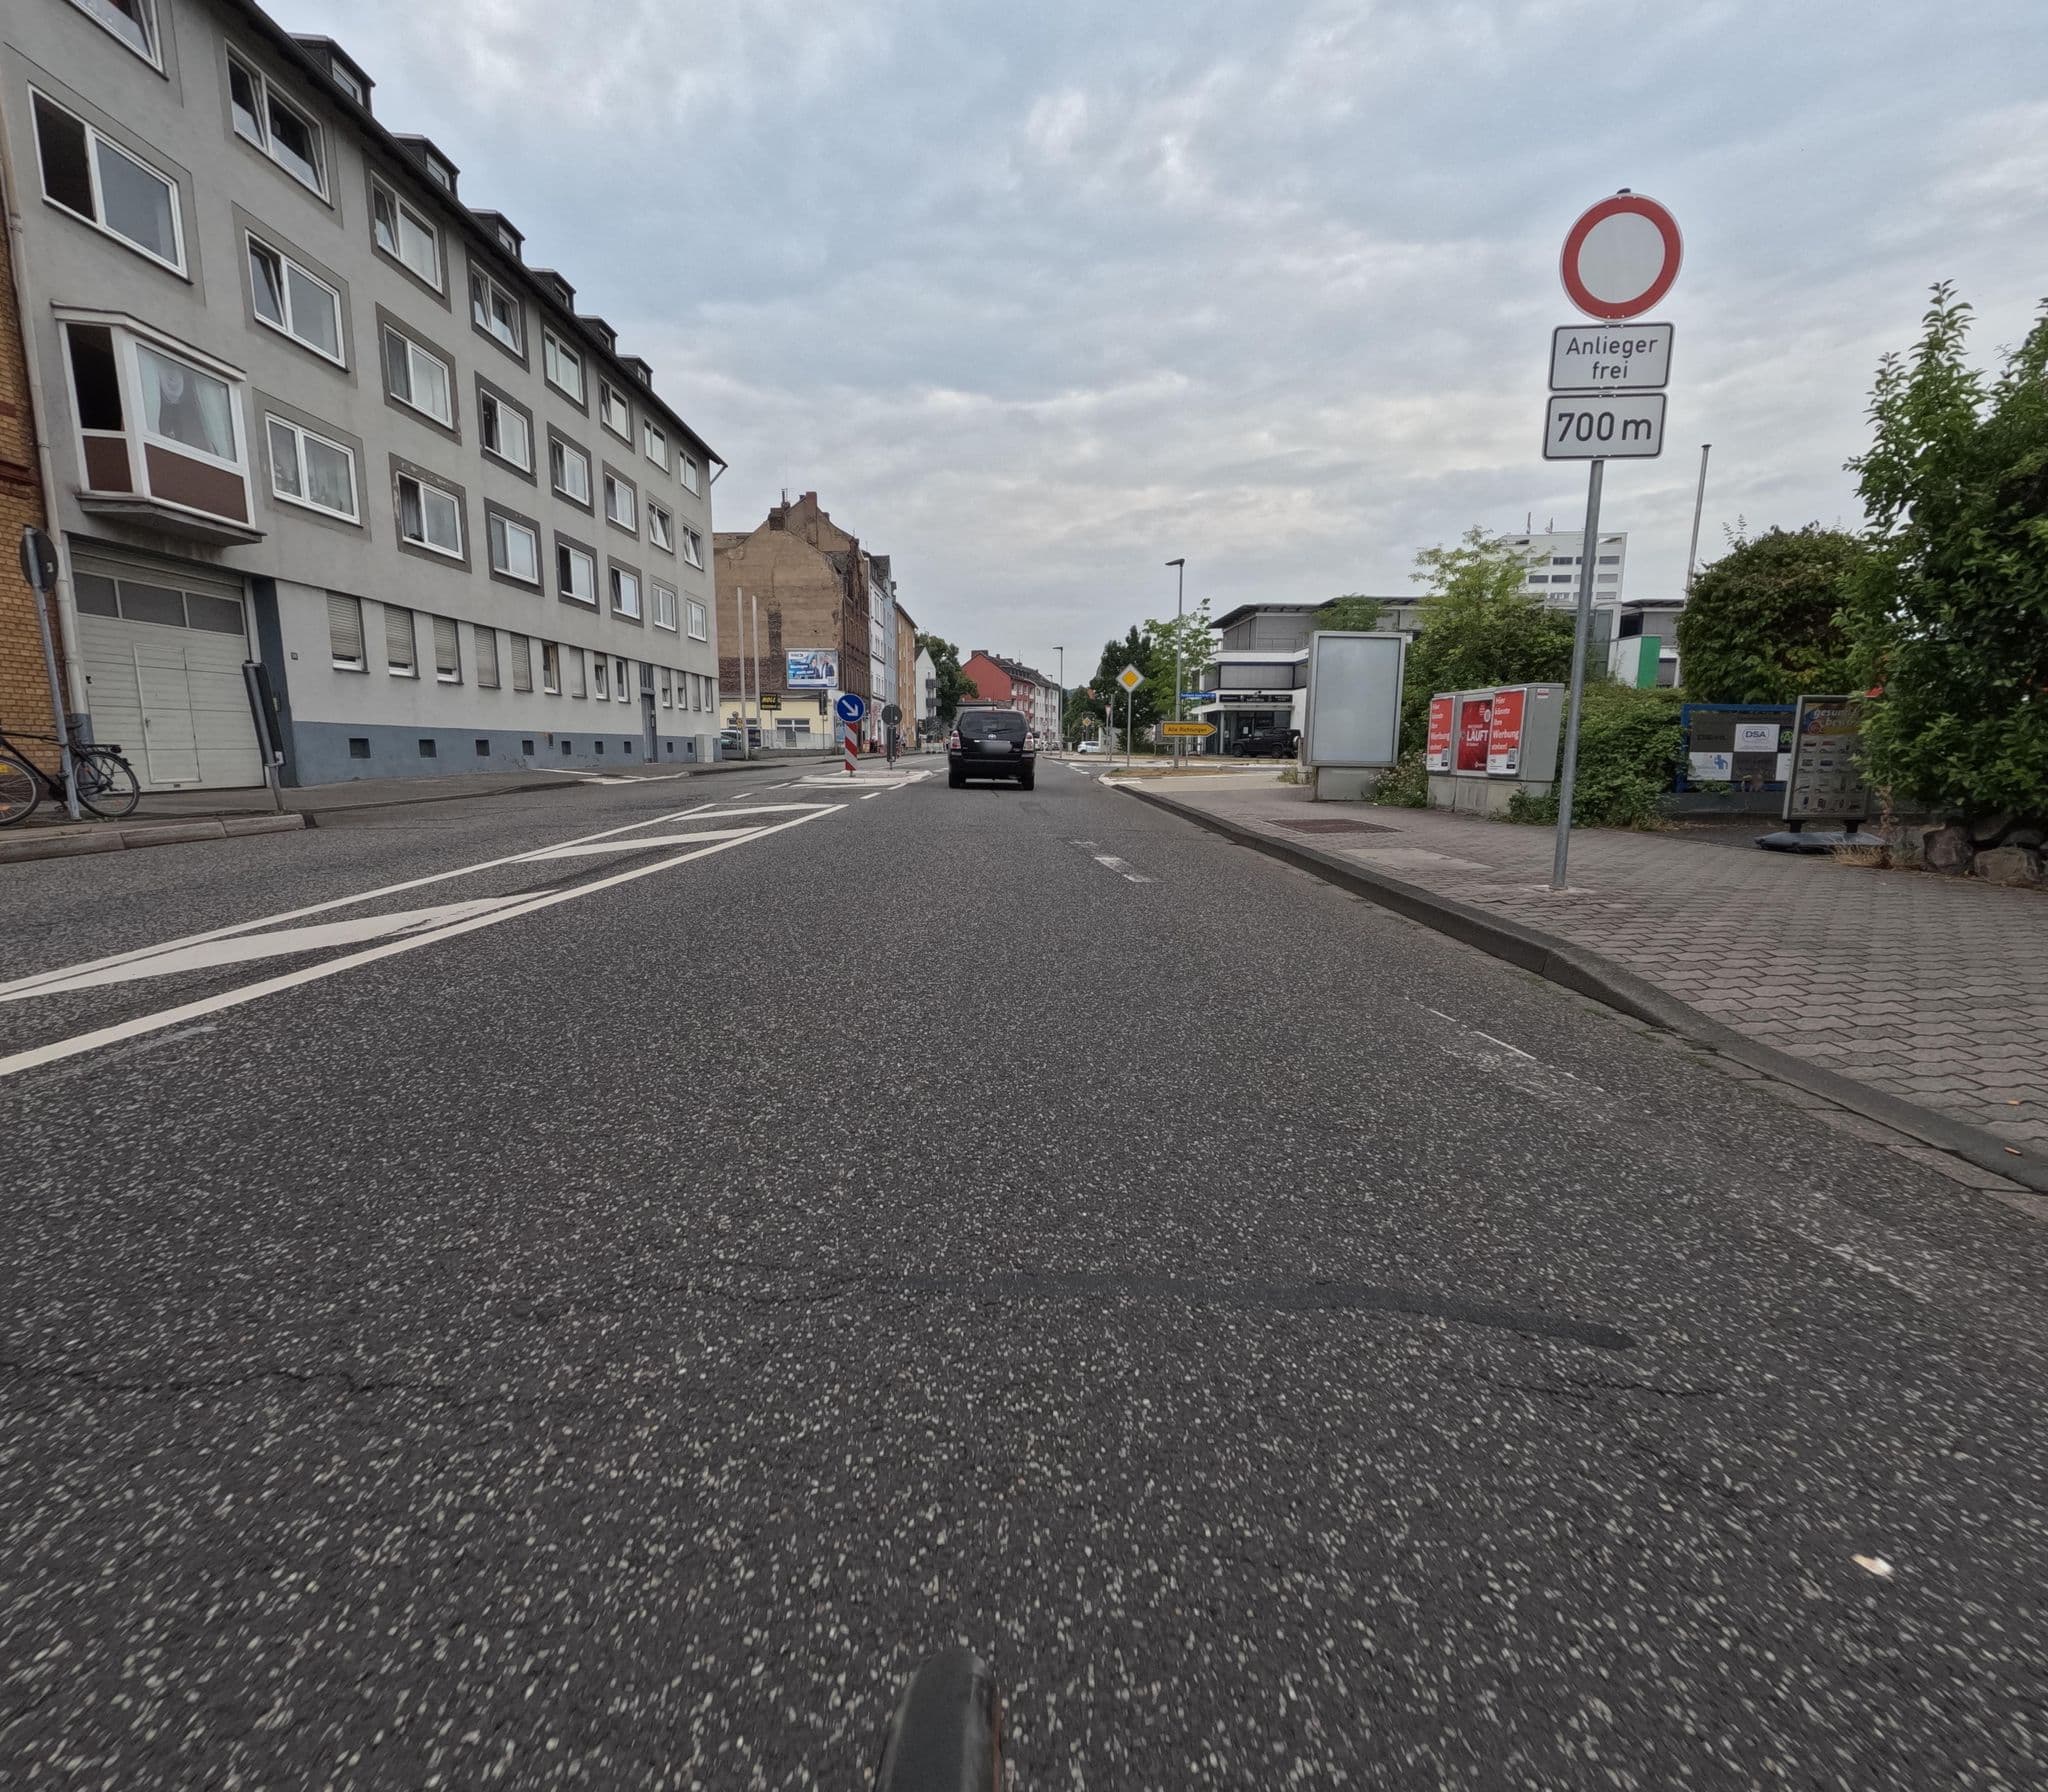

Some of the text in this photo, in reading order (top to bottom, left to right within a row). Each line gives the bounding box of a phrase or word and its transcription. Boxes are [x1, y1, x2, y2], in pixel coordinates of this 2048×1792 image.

[1566, 336, 1658, 359] Anlieger
[1592, 360, 1628, 380] frei
[1557, 411, 1651, 442] 700 m
[1495, 696, 1506, 705] Hier
[1180, 726, 1208, 734] Richtungen
[1466, 727, 1489, 742] LÄUFT
[1492, 730, 1519, 740] Werbung
[1745, 730, 1767, 738] DSA
